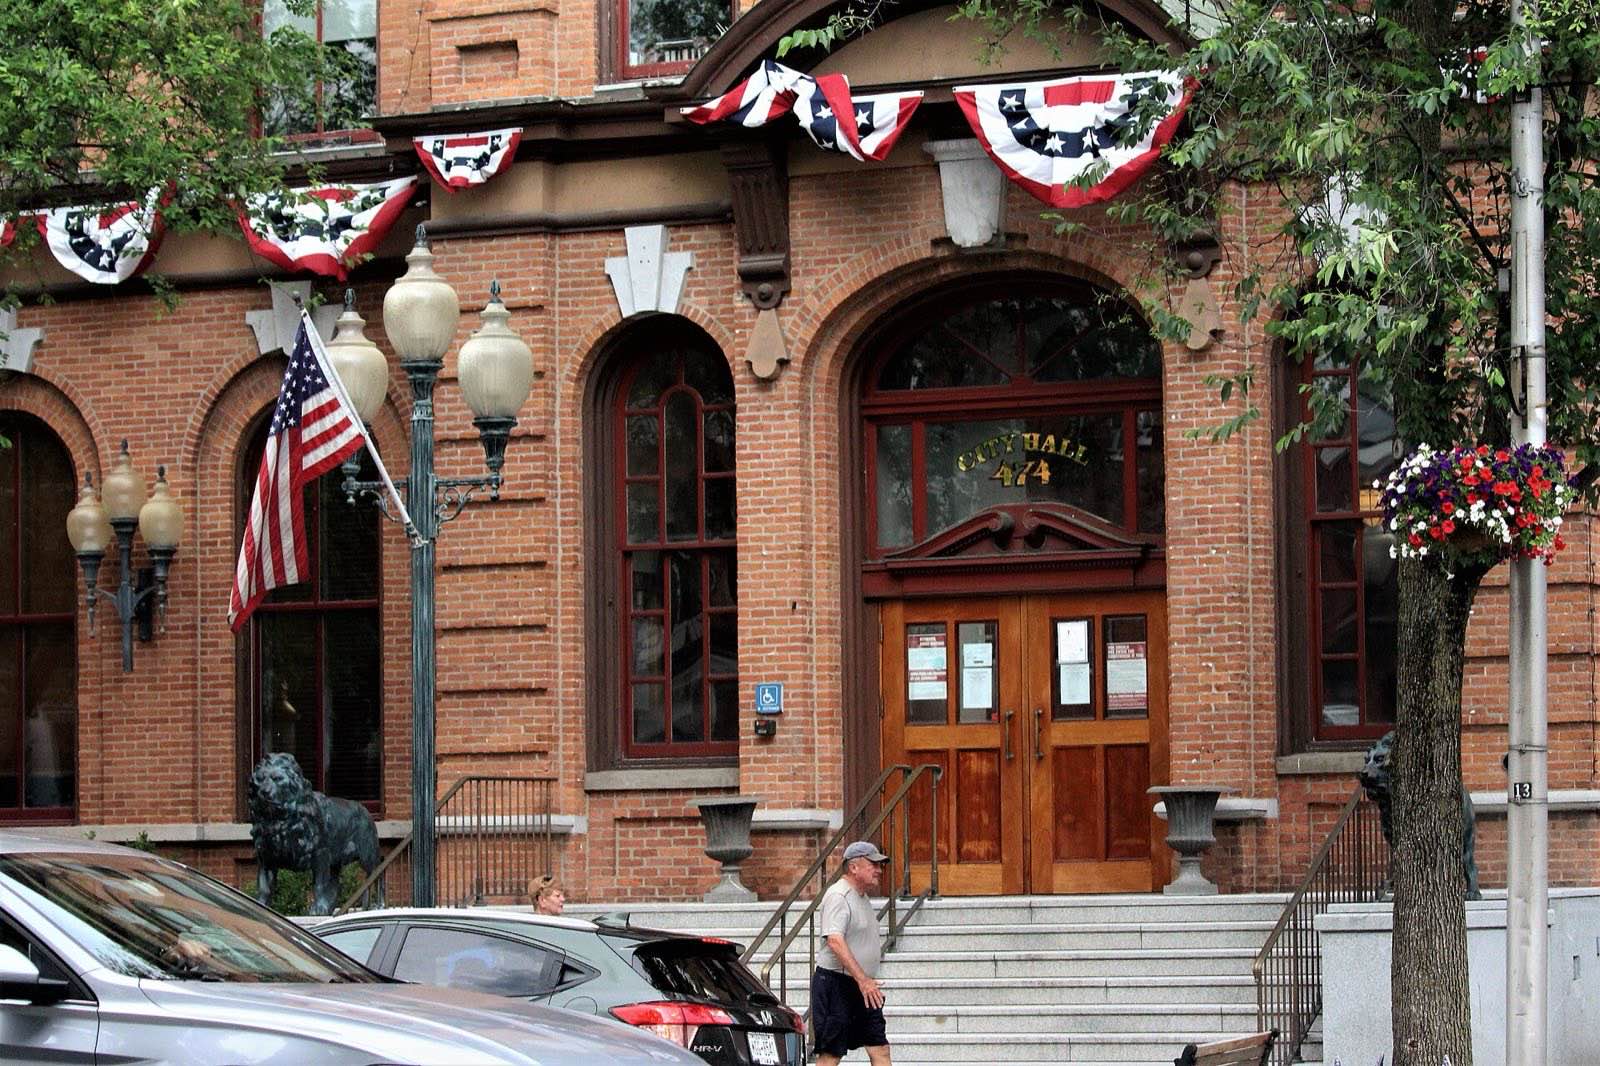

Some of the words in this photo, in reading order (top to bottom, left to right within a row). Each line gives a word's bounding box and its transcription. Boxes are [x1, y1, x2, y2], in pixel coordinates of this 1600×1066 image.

[956, 433, 1016, 472] CITY
[1021, 432, 1089, 466] HALL
[990, 458, 1051, 487] 474
[1515, 783, 1530, 799] 13
[693, 1045, 723, 1053] HR-V
